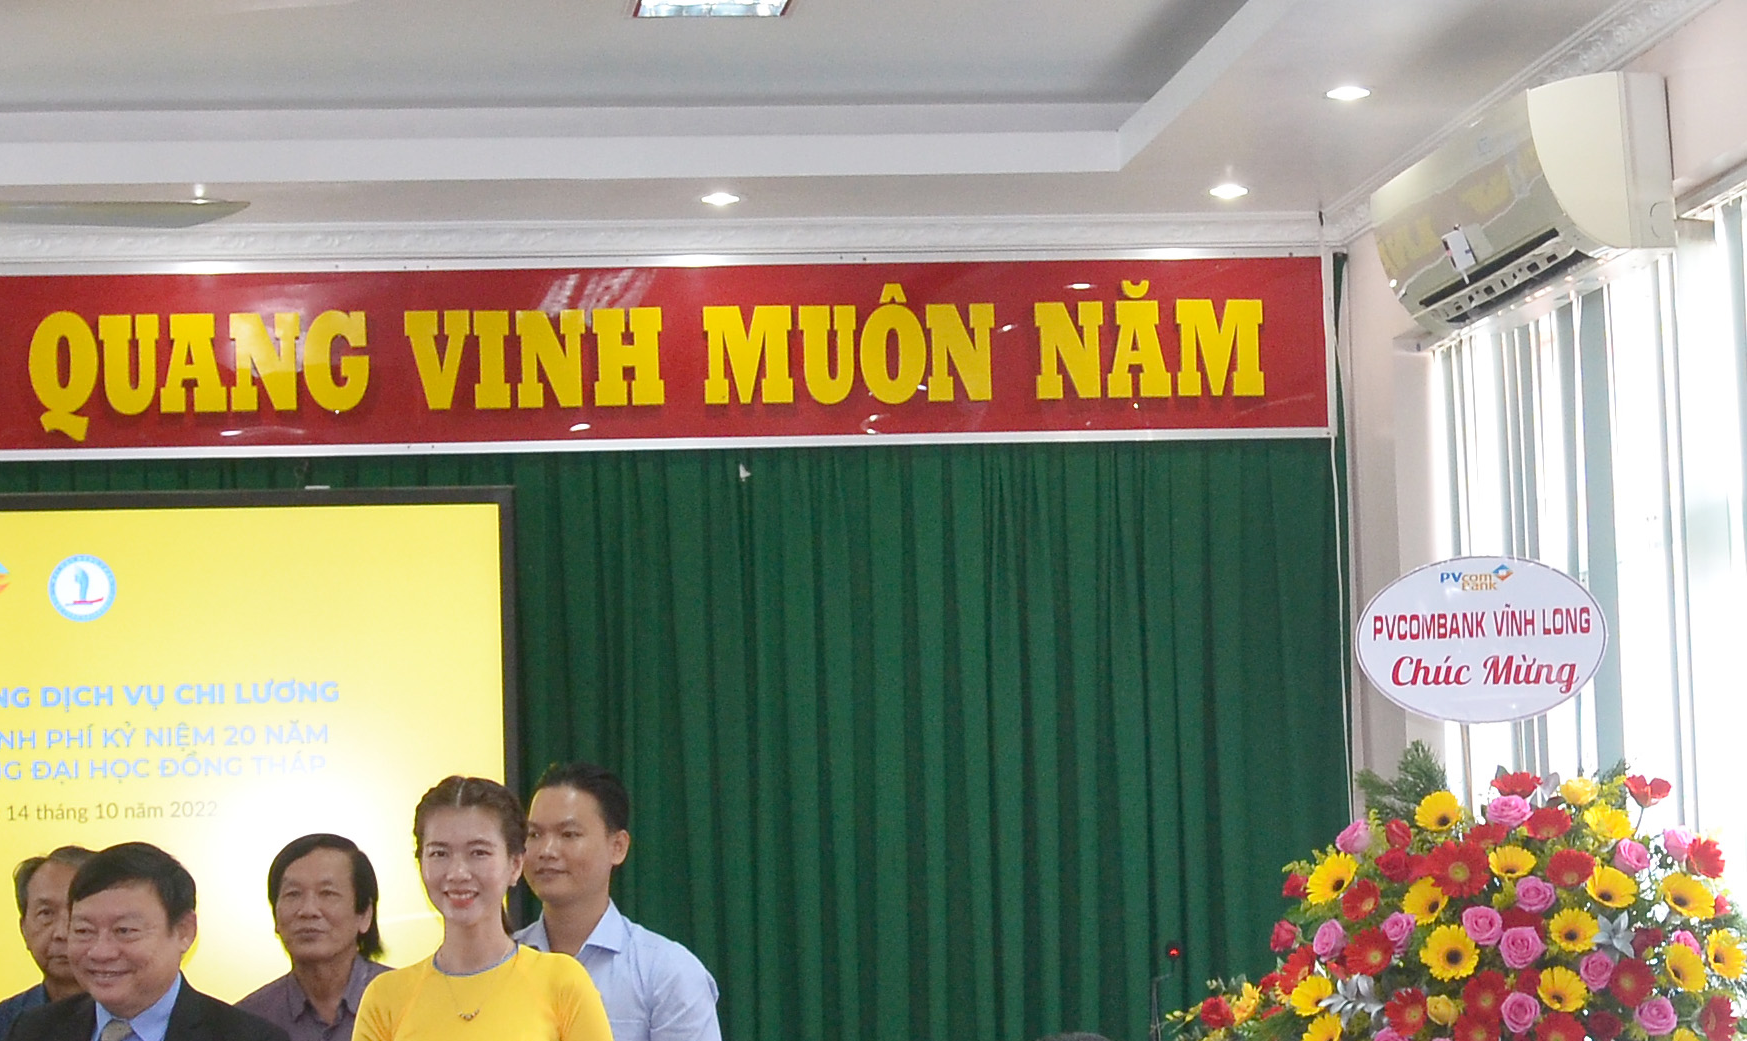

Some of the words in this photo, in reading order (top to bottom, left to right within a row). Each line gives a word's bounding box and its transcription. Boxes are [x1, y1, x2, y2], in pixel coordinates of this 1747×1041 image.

[28, 310, 370, 441] QUANG
[405, 307, 664, 410] VINH
[703, 283, 995, 405] MUÔN
[1035, 280, 1266, 398] NĂM
[1373, 611, 1487, 641] PVCOMBANK
[1493, 604, 1535, 637] VĨNH
[1542, 607, 1591, 635] LONG
[1391, 655, 1472, 686] Chúc
[1482, 654, 1580, 694] Mừng
[41, 685, 113, 712] DỊCH
[123, 684, 165, 711] VỤ
[174, 683, 224, 705] CHI
[236, 679, 339, 704] LƯƠNG
[46, 724, 93, 749] PHÍ
[103, 721, 137, 748] KỶ
[145, 722, 215, 752] NIỆM
[223, 726, 256, 746] 20
[265, 720, 328, 745] NĂM
[31, 759, 79, 784] ĐẠI
[89, 758, 150, 783] HỌC
[158, 751, 243, 778] ĐỒNG
[252, 751, 326, 775] THÁP
[7, 805, 29, 821] 14
[36, 804, 88, 823] tháng
[95, 803, 119, 819] 10
[125, 803, 163, 819] năm
[169, 801, 218, 818] 2022
